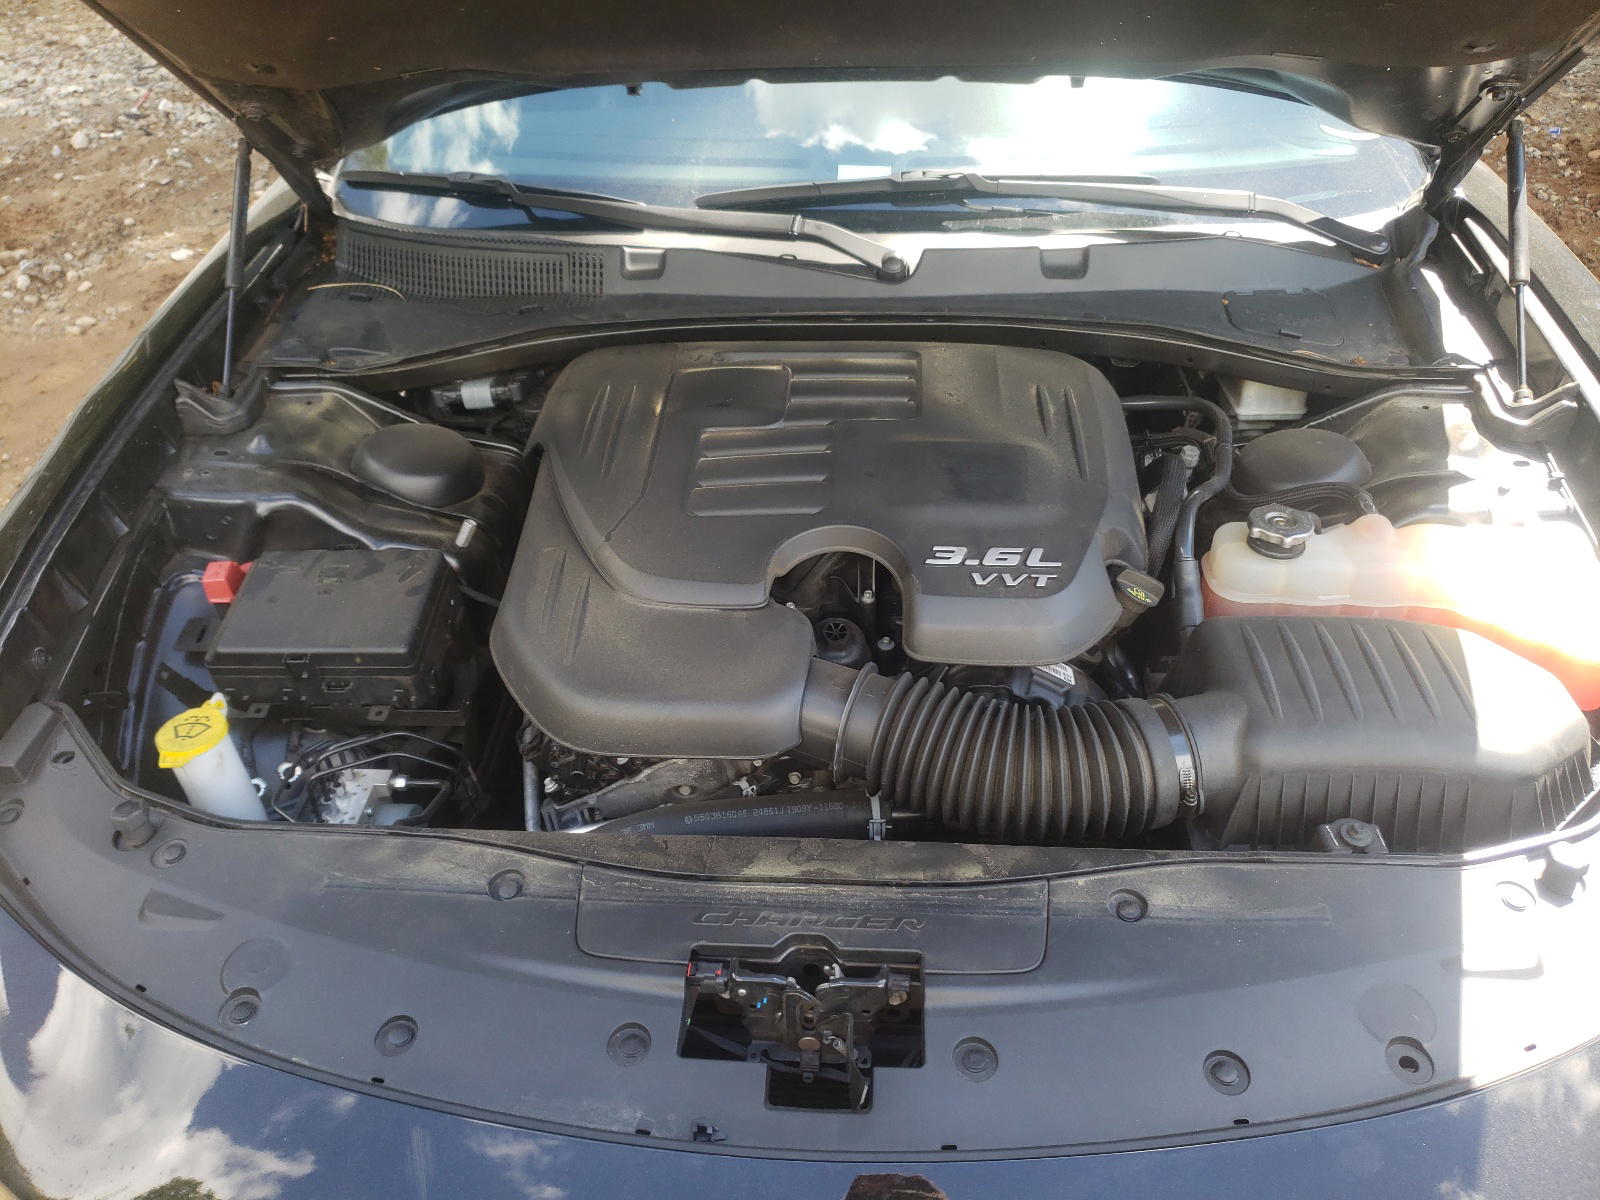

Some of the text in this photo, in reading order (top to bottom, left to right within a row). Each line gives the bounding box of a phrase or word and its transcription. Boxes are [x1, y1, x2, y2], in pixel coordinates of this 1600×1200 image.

[924, 546, 1063, 567] 3.6L
[970, 572, 1059, 587] VVT
[692, 911, 926, 932] CHARGER
